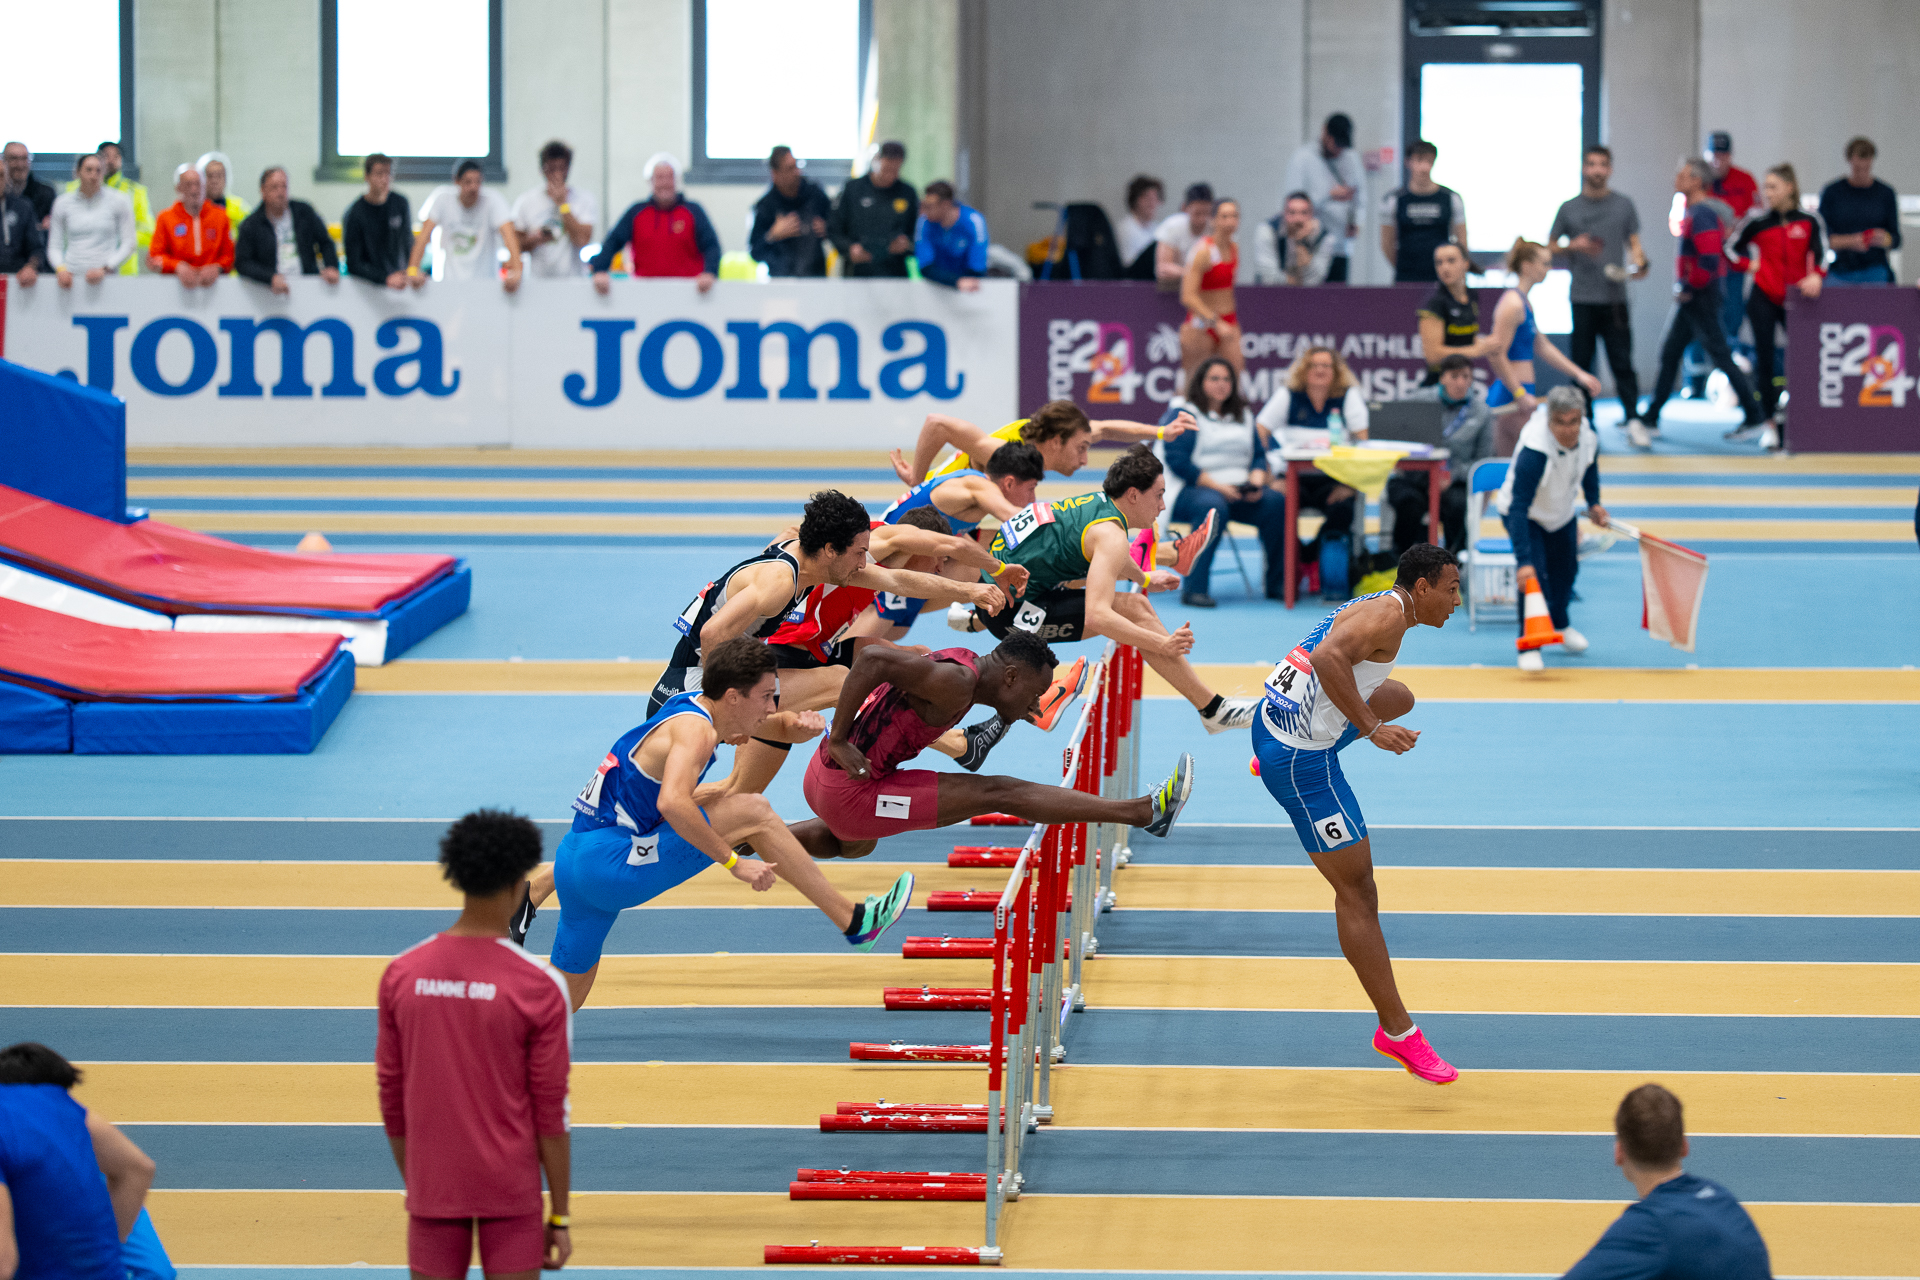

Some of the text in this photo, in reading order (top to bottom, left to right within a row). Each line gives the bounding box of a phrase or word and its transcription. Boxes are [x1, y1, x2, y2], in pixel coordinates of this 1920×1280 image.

[55, 315, 461, 397] Joma
[1240, 332, 1336, 359] OPEAN
[562, 319, 965, 408] Joma
[1011, 508, 1035, 533] 95
[1021, 610, 1040, 627] 3
[1272, 665, 1298, 695] 94
[1275, 695, 1293, 710] 2024
[1324, 821, 1343, 840] 6
[414, 977, 497, 1001] FIAMME ORO
